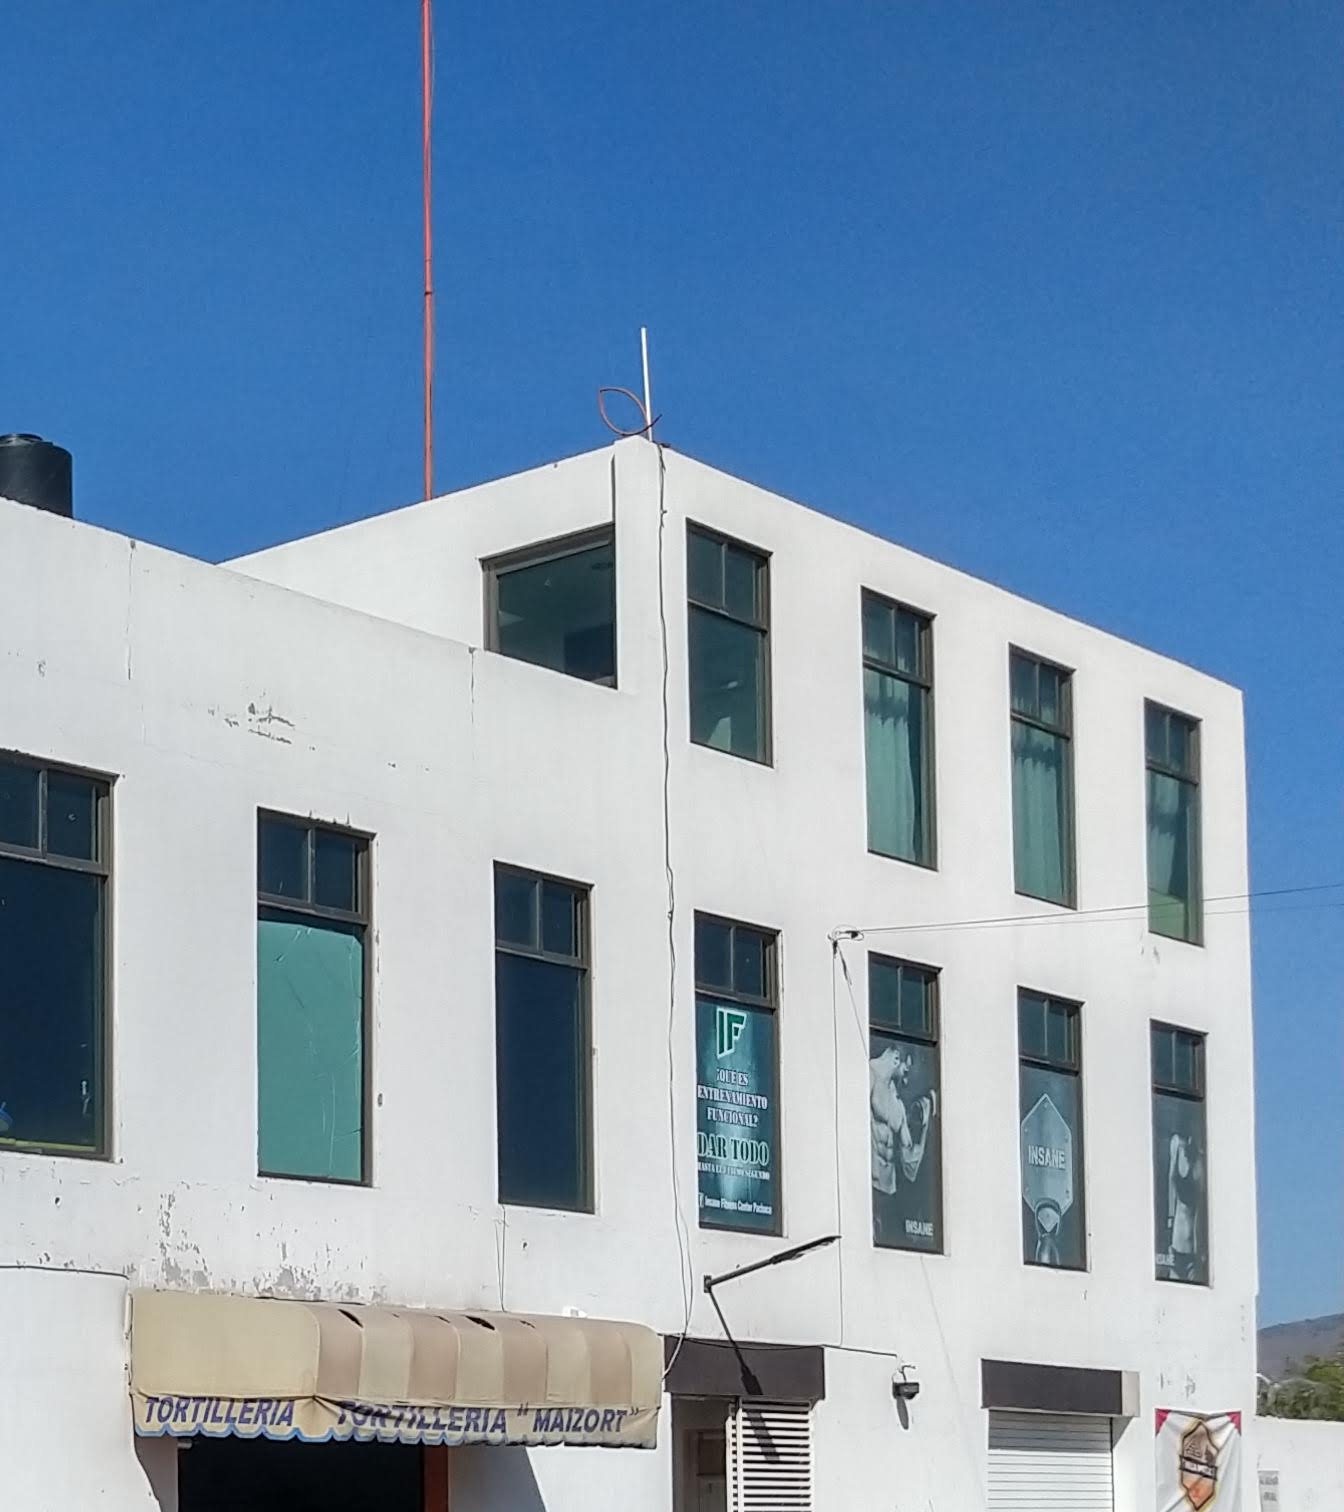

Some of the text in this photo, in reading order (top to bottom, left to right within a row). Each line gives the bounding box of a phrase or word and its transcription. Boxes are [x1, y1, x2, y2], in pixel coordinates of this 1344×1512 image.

[738, 1072, 749, 1085] ES
[697, 1084, 768, 1109] ENTRENAMIENTO
[707, 1106, 759, 1127] FUNCIONAL?
[697, 1131, 770, 1166] DAR TODO
[1028, 1144, 1065, 1169] INSANE
[905, 1219, 934, 1237] INSANE
[145, 1396, 296, 1427] TORTILLERIA
